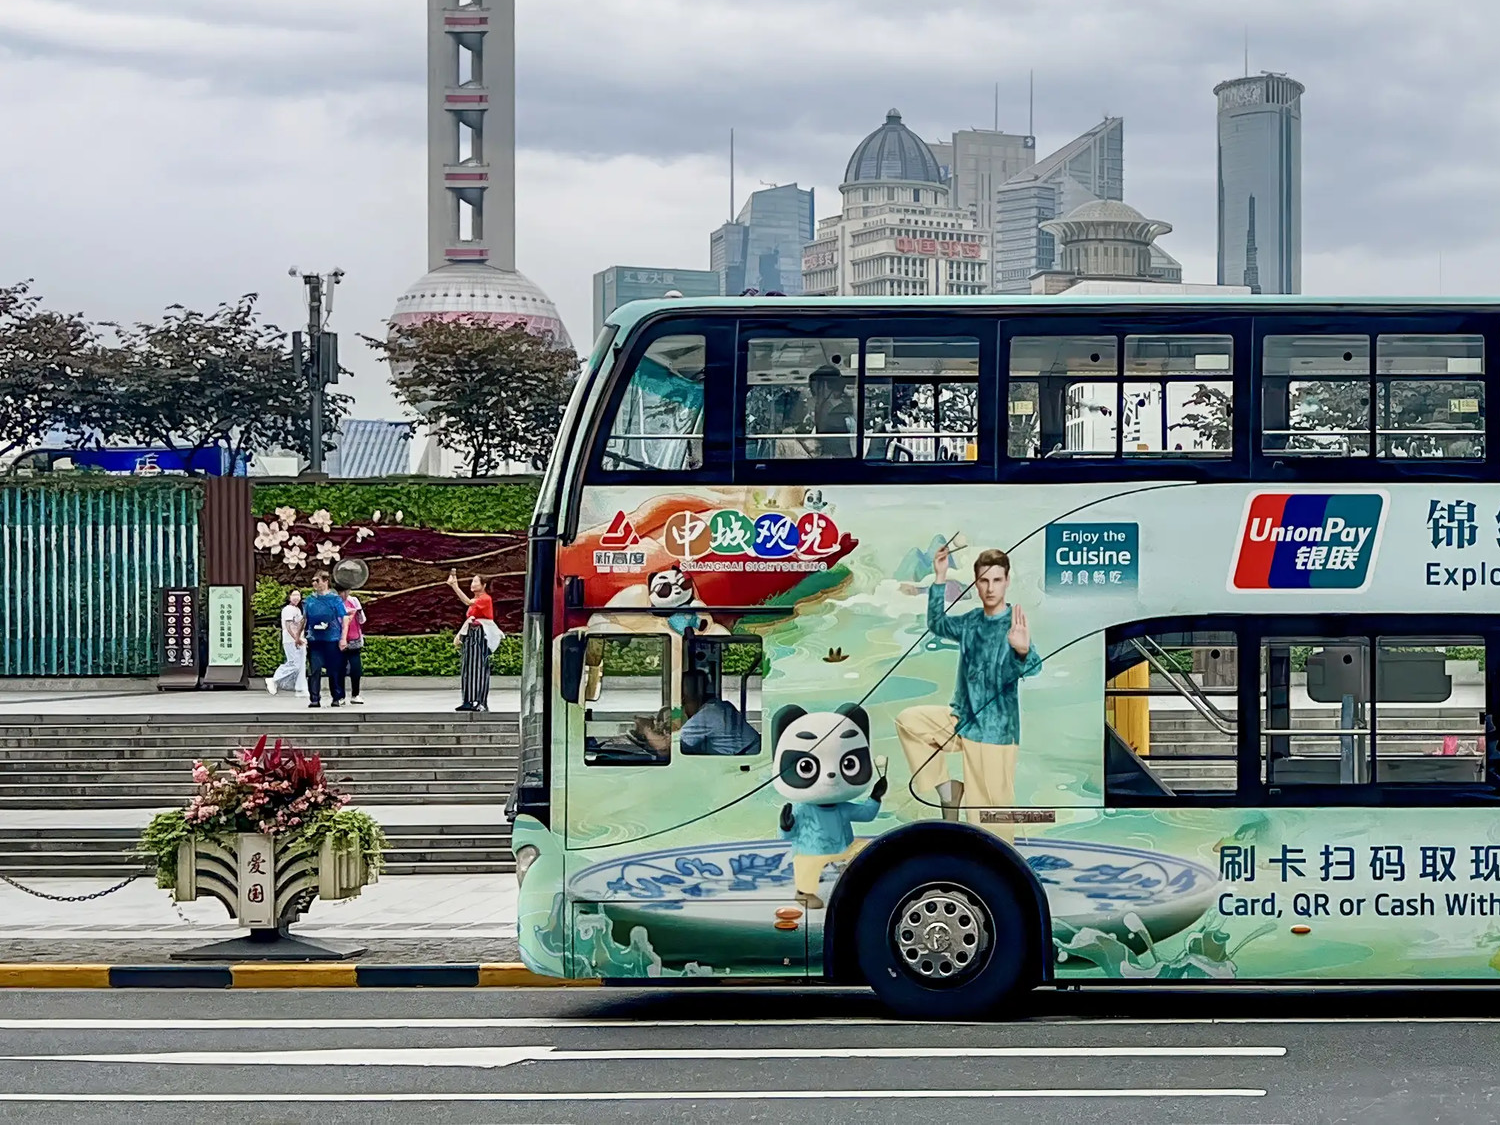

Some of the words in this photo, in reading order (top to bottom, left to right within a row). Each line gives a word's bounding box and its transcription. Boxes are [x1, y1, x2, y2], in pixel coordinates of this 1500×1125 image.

[670, 511, 841, 561] 申城观光
[1062, 530, 1100, 544] Enjoy
[1103, 530, 1126, 542] the
[1249, 517, 1372, 550] UnionPay
[594, 551, 645, 566] 新高度
[1056, 547, 1132, 565] Cuisine
[1294, 545, 1360, 570] 银联
[1060, 570, 1123, 585] 美食畅吃
[247, 852, 267, 903] 爱国
[1218, 892, 1284, 918] Card,
[1292, 892, 1332, 918] QR
[1338, 897, 1367, 917] or
[1374, 892, 1435, 917] Cash
